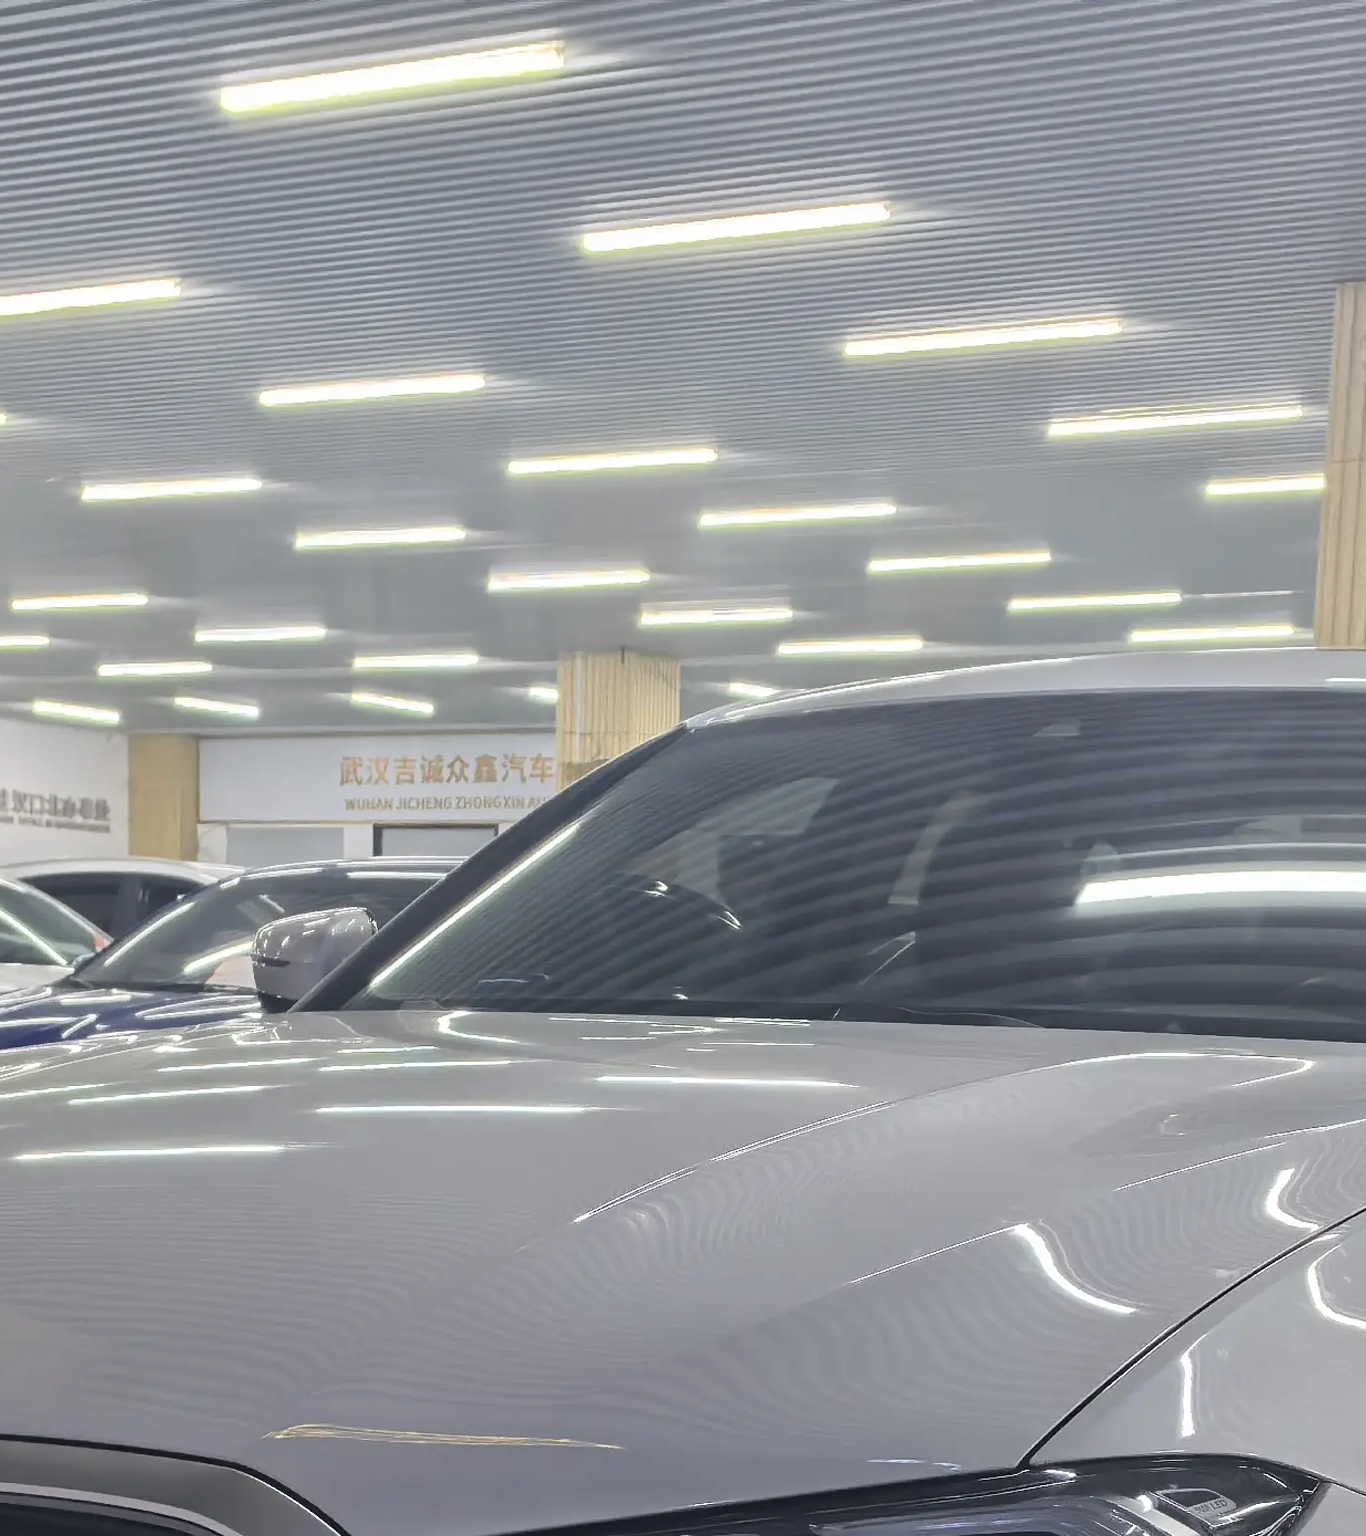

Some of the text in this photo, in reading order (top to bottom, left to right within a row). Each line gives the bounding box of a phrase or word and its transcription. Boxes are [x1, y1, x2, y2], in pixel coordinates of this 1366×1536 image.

[339, 753, 555, 787] 武汉吉诚众鑫汽车
[344, 797, 393, 811] WUHAN
[396, 797, 453, 810] JICHENG
